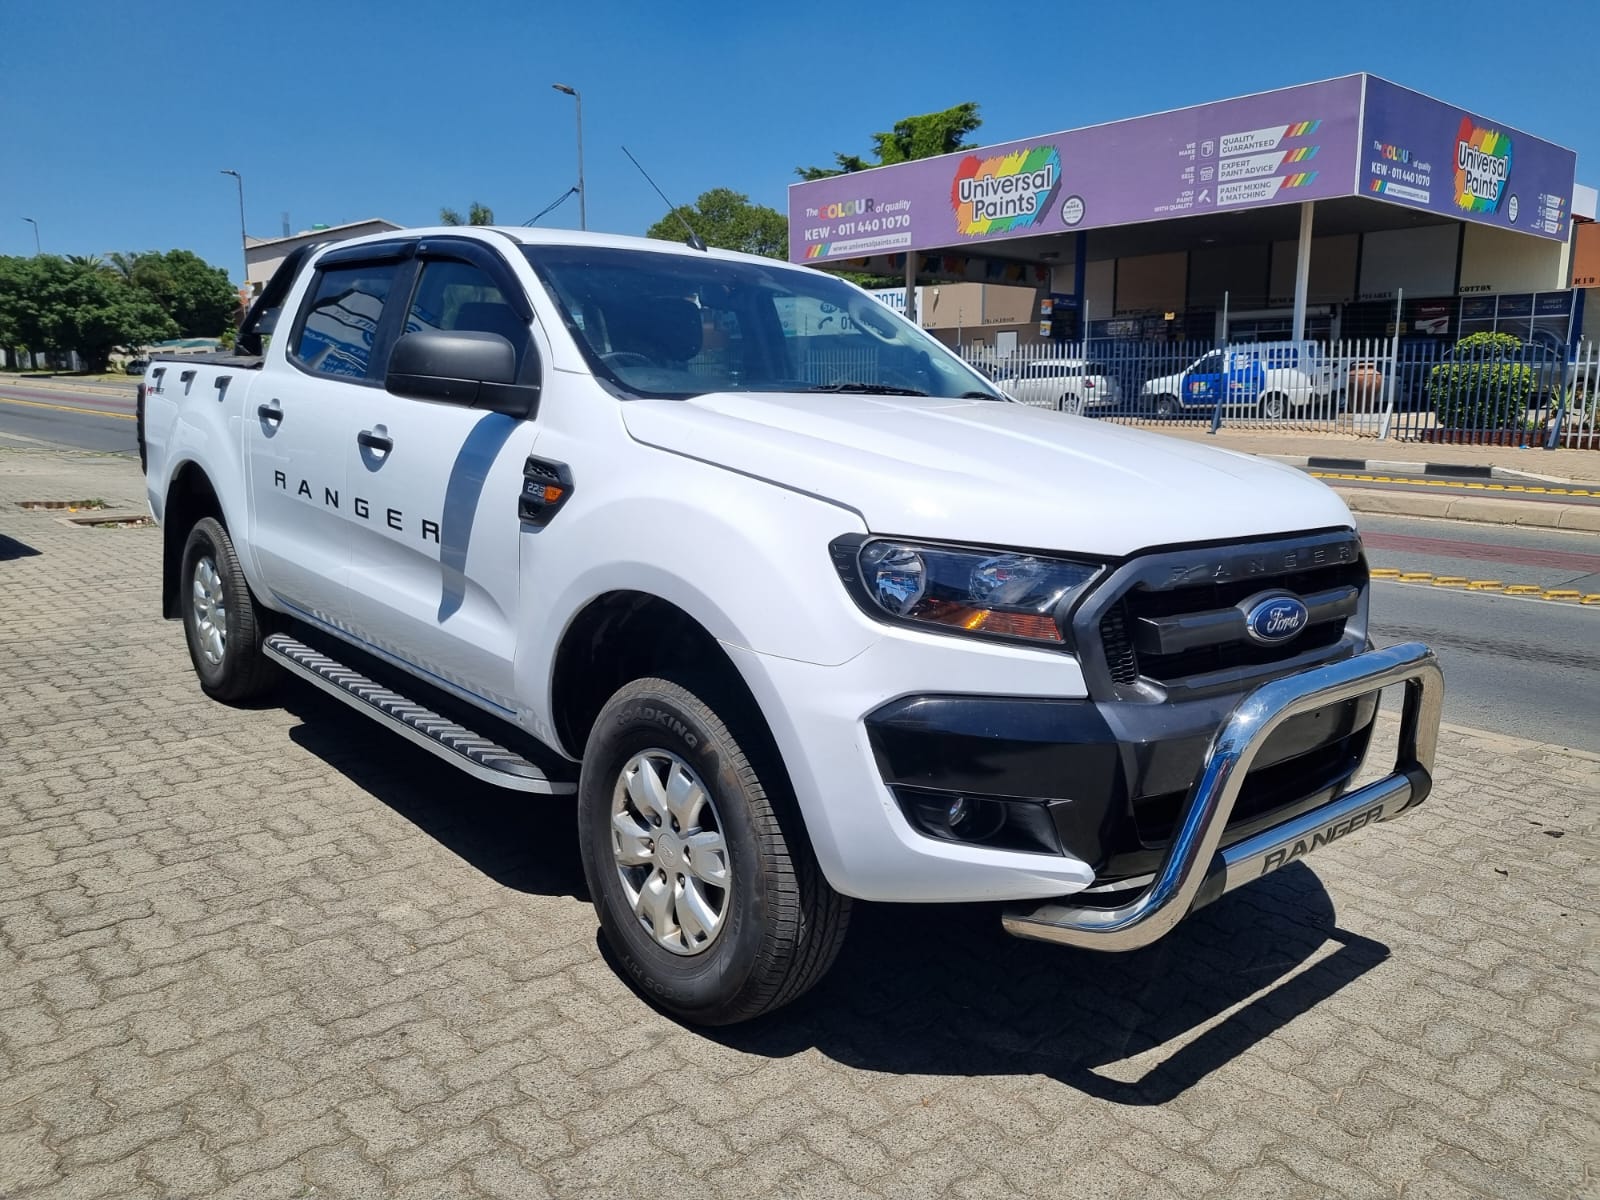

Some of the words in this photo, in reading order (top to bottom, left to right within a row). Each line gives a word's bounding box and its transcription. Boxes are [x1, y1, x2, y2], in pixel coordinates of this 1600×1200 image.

[1222, 139, 1275, 154] GUARANTEED
[1223, 134, 1255, 146] QUALITY
[1221, 160, 1250, 170] EXPERT
[1221, 169, 1243, 178] PAINT
[1245, 164, 1273, 174] ADVICE
[1459, 142, 1507, 179] Universal
[960, 165, 1052, 202] Universal
[1371, 161, 1388, 176] KEW
[1415, 173, 1430, 187] 1070
[1465, 170, 1497, 199] Paints
[1220, 185, 1242, 194] PAINT
[1243, 181, 1271, 191] MIXING
[1225, 190, 1267, 200] MATCHING
[806, 208, 818, 217] The
[819, 198, 874, 220] COLOUR
[875, 203, 884, 214] of
[884, 199, 912, 214] quality
[974, 194, 1037, 220] Paints
[804, 226, 830, 241] KEW
[838, 222, 855, 236] 011
[857, 219, 879, 233] 440
[881, 214, 911, 230] 1070
[274, 470, 440, 544] RANGER
[1267, 606, 1299, 633] Ford
[1261, 804, 1385, 874] RANGER
